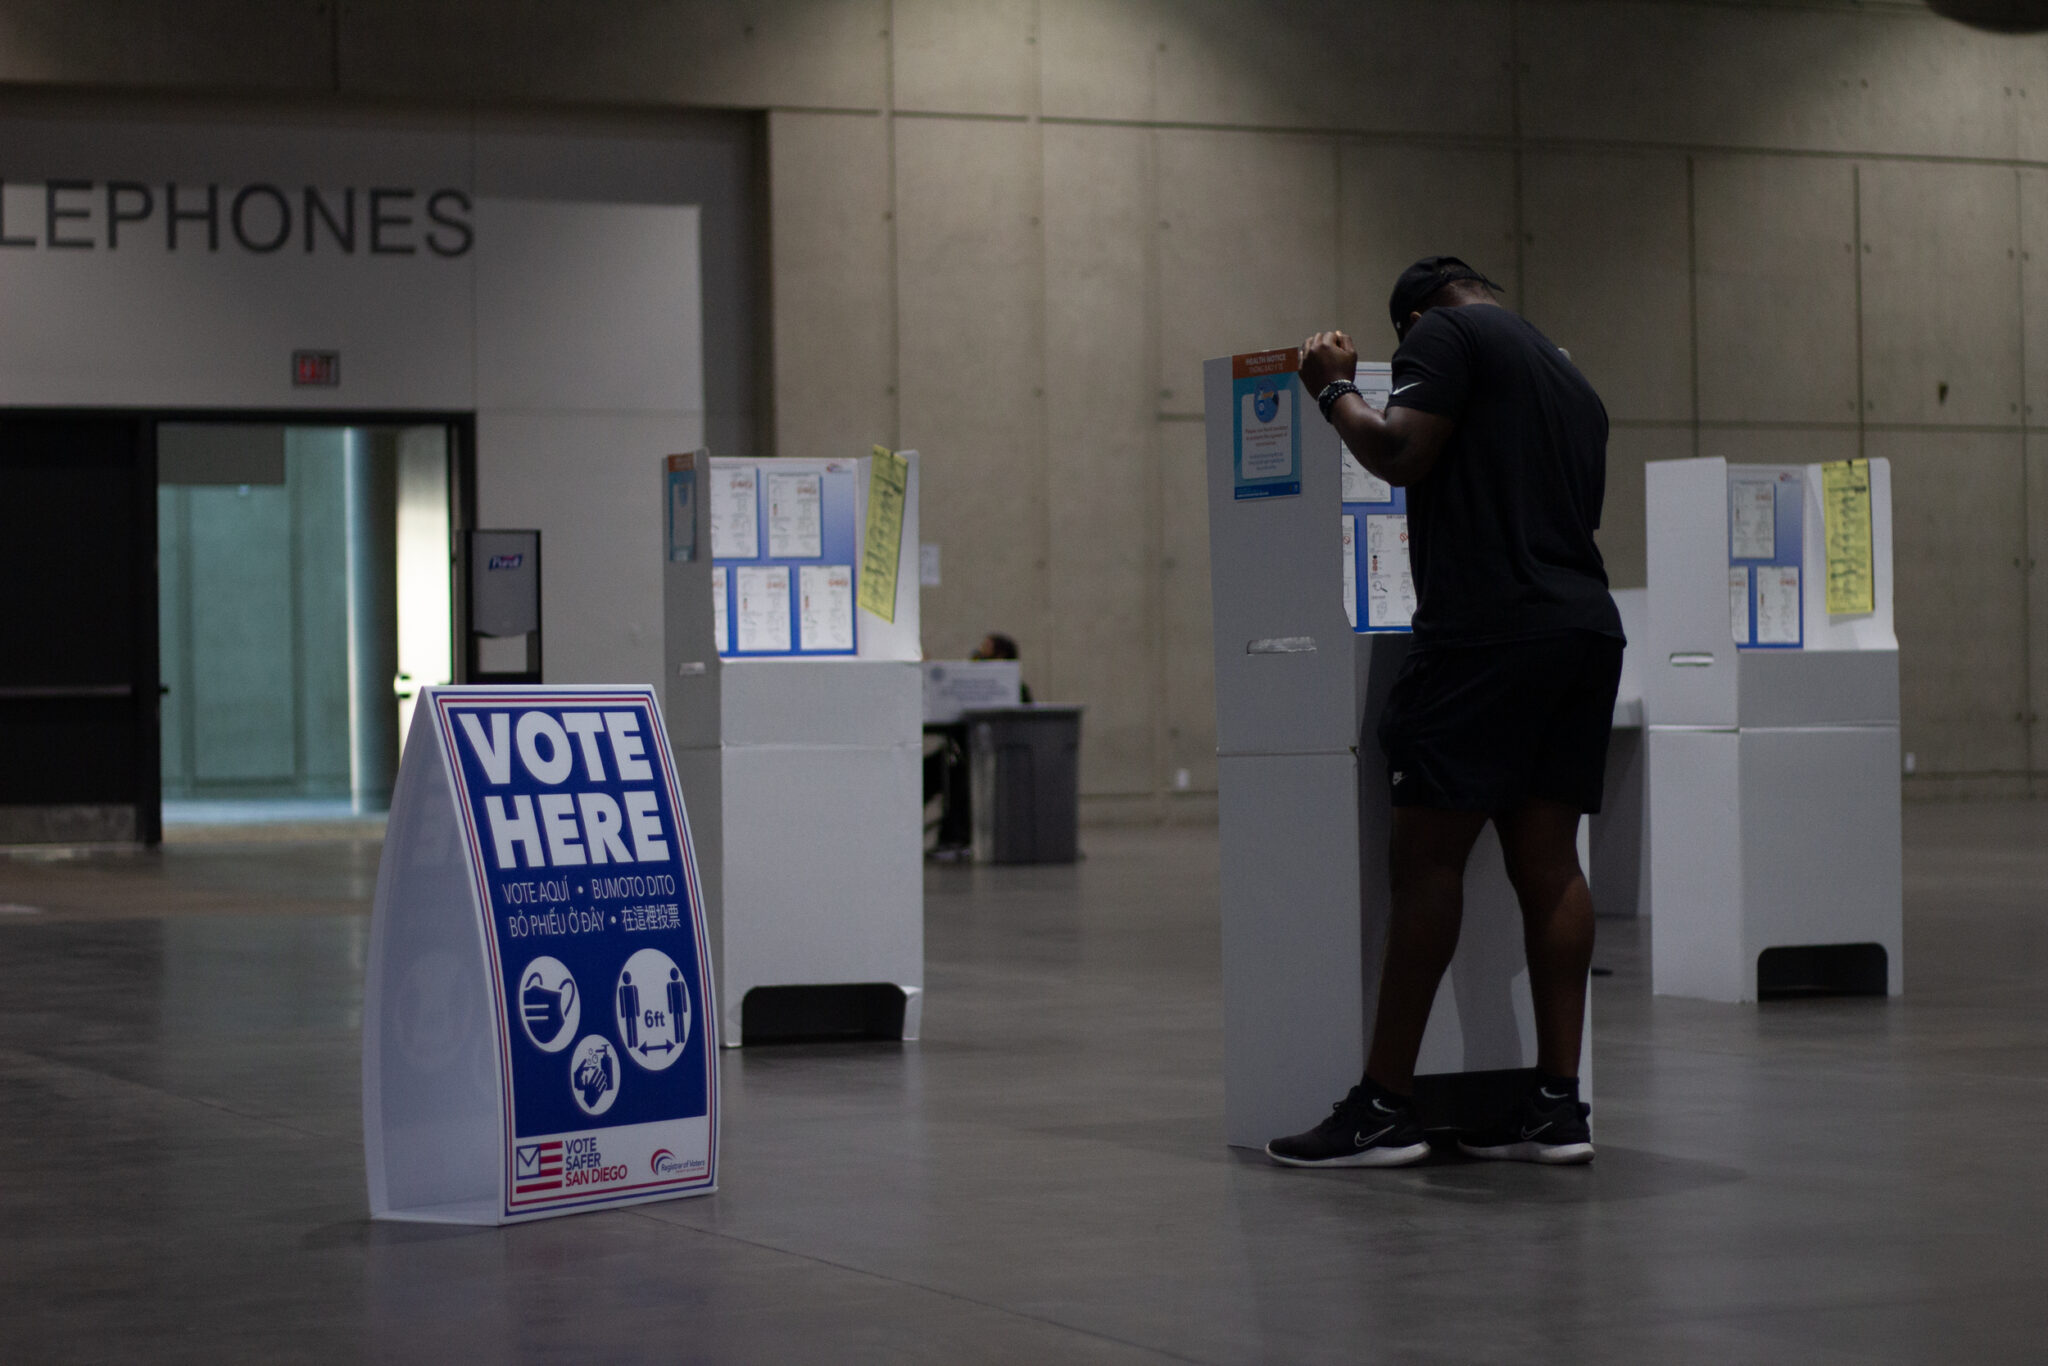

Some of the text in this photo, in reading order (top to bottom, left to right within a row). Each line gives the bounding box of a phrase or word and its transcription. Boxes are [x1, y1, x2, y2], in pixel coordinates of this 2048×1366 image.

[0, 180, 474, 257] LEPHONES
[457, 710, 654, 785] VOTE
[484, 790, 670, 869] HERE
[502, 875, 571, 905] VOTE AQUÍ
[591, 874, 676, 900] BUMOTO DITO
[508, 909, 529, 938] BỎ
[644, 1009, 666, 1029] 6ft
[565, 1137, 597, 1154] VOTE
[565, 1152, 602, 1171] SAFER
[565, 1164, 628, 1188] SAN DIEGO
